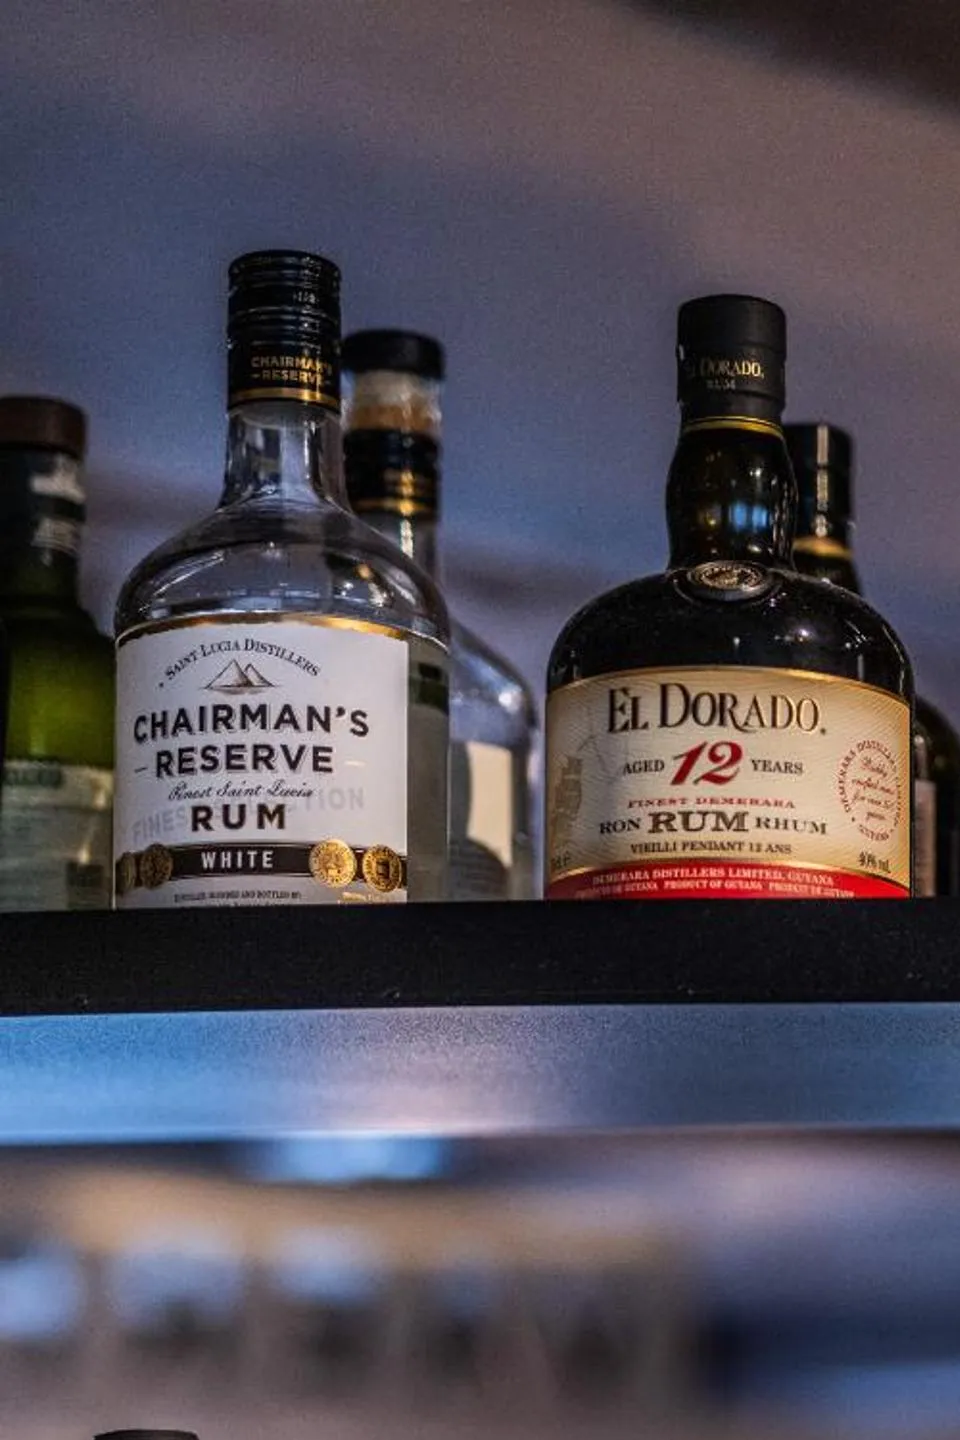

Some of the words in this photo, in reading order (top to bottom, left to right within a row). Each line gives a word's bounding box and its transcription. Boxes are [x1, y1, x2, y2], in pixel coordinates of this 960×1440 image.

[164, 651, 198, 680] SAINT
[201, 640, 240, 659] LUCIA
[244, 638, 321, 677] DISTILLERS
[133, 703, 370, 744] CHAIRMAN'S
[607, 686, 649, 734] EL
[155, 743, 333, 778] RESERVE
[622, 759, 665, 775] AGED
[670, 740, 743, 786] 12
[751, 759, 803, 775] YEARS
[168, 781, 212, 801] Finest
[216, 780, 262, 798] Saint
[266, 780, 314, 799] Lucia
[628, 798, 687, 809] FINEST
[190, 803, 286, 832] RUM
[600, 817, 642, 835] RON
[648, 810, 750, 834] RUM
[755, 816, 828, 835] RHUM
[200, 850, 275, 870] WHITE
[681, 840, 746, 852] PENDANT
[764, 843, 793, 855] ANS
[652, 867, 726, 879] DISTILLERS
[787, 870, 835, 887] GUYANA
